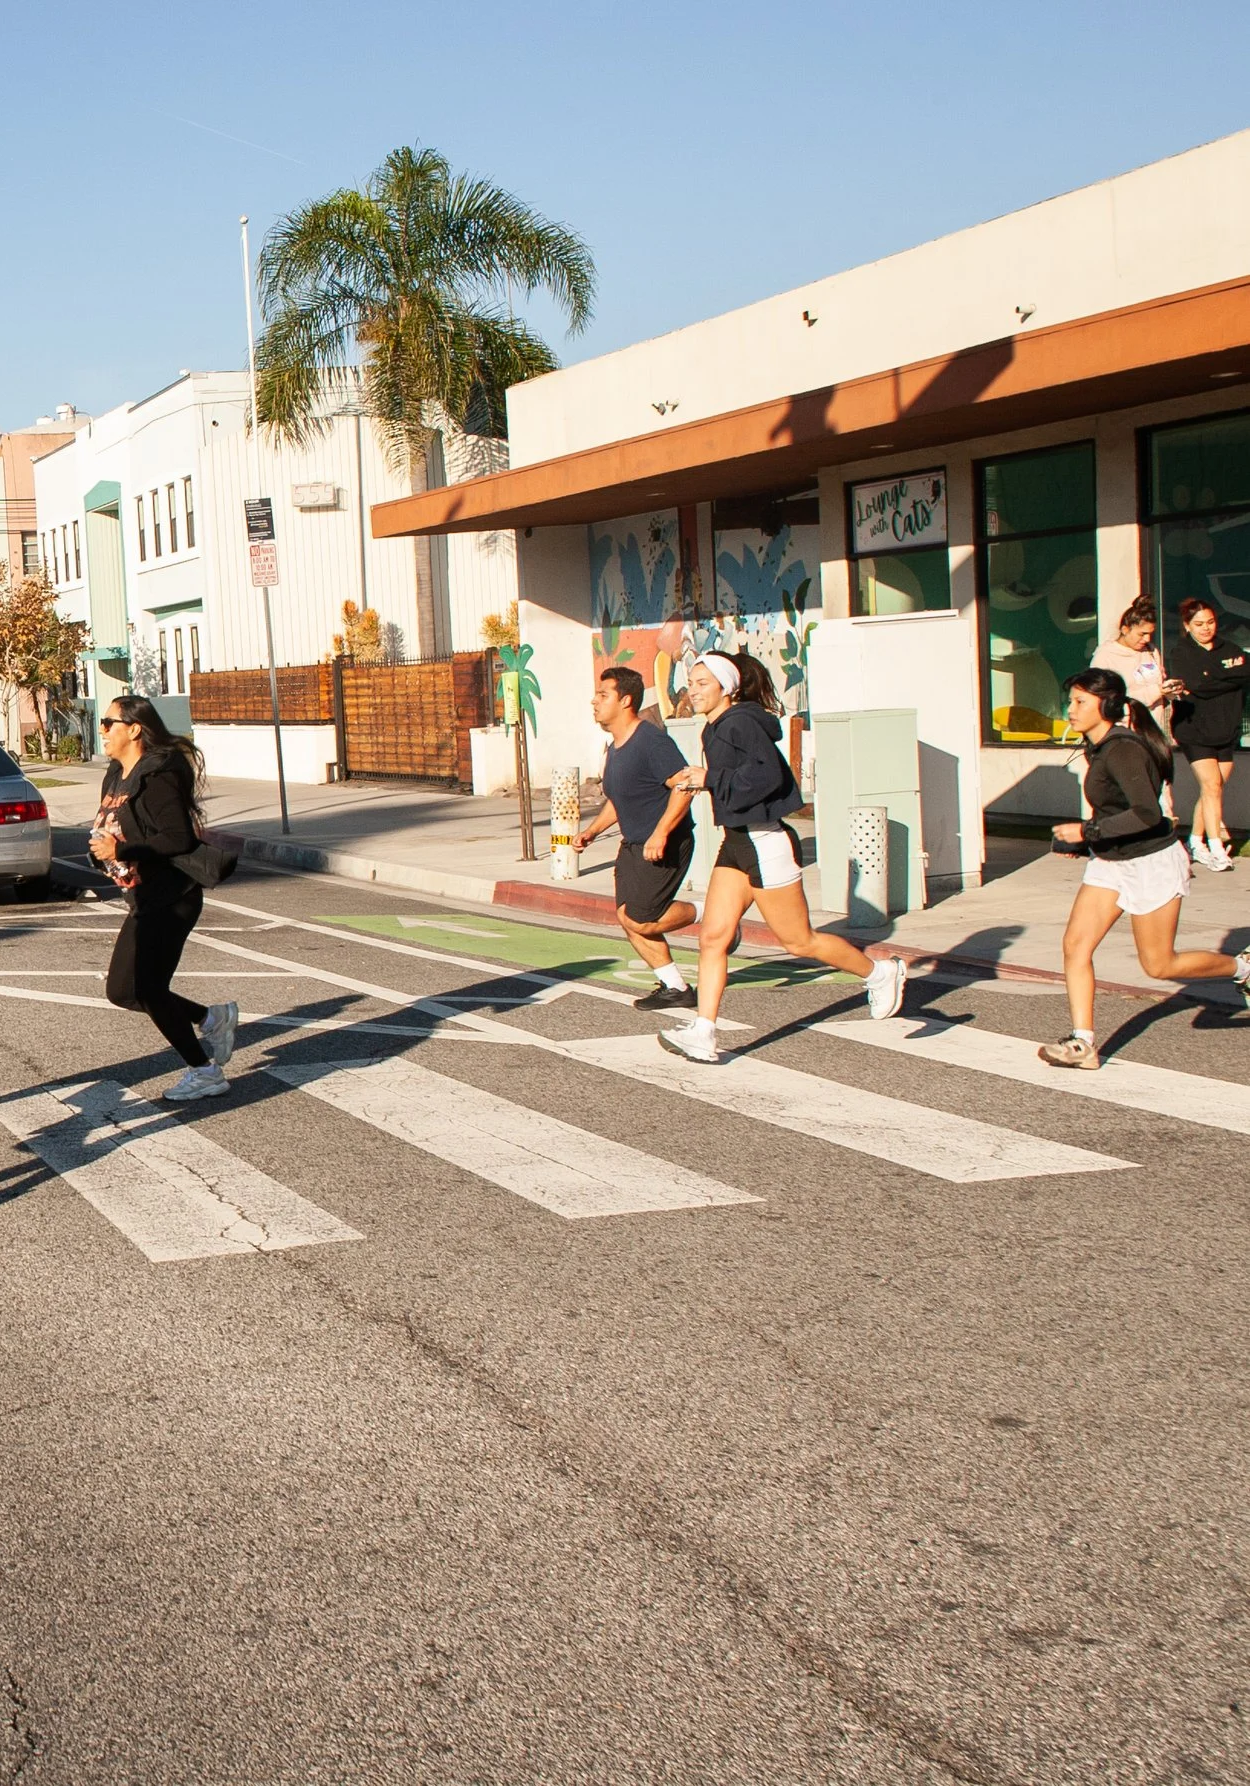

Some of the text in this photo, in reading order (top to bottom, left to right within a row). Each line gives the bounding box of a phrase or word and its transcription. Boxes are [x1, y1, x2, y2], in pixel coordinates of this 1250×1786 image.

[857, 480, 908, 527] Lounge
[870, 499, 931, 542] with Cats
